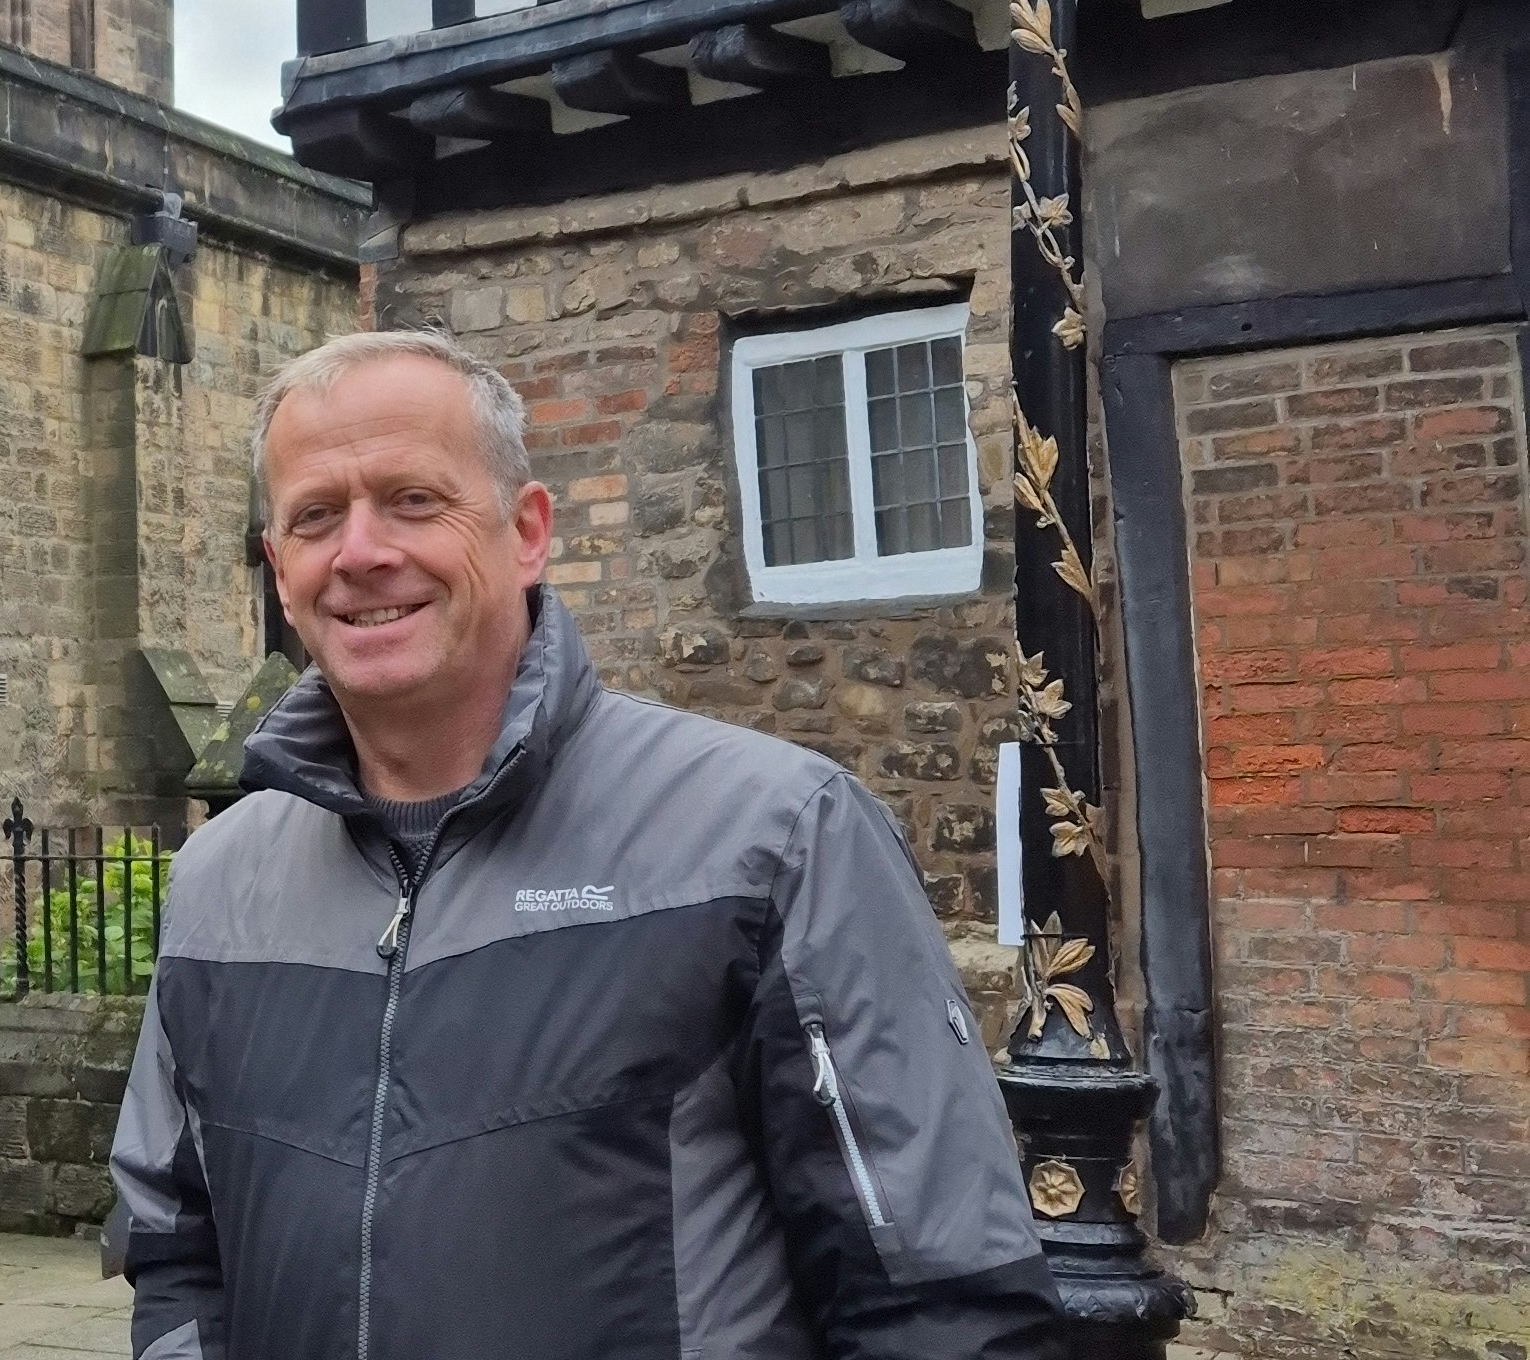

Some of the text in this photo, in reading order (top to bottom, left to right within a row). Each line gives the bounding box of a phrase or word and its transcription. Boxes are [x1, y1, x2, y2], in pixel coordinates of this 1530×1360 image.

[515, 887, 579, 902] REGATTA
[514, 899, 614, 912] GREAT OUTDOORS
